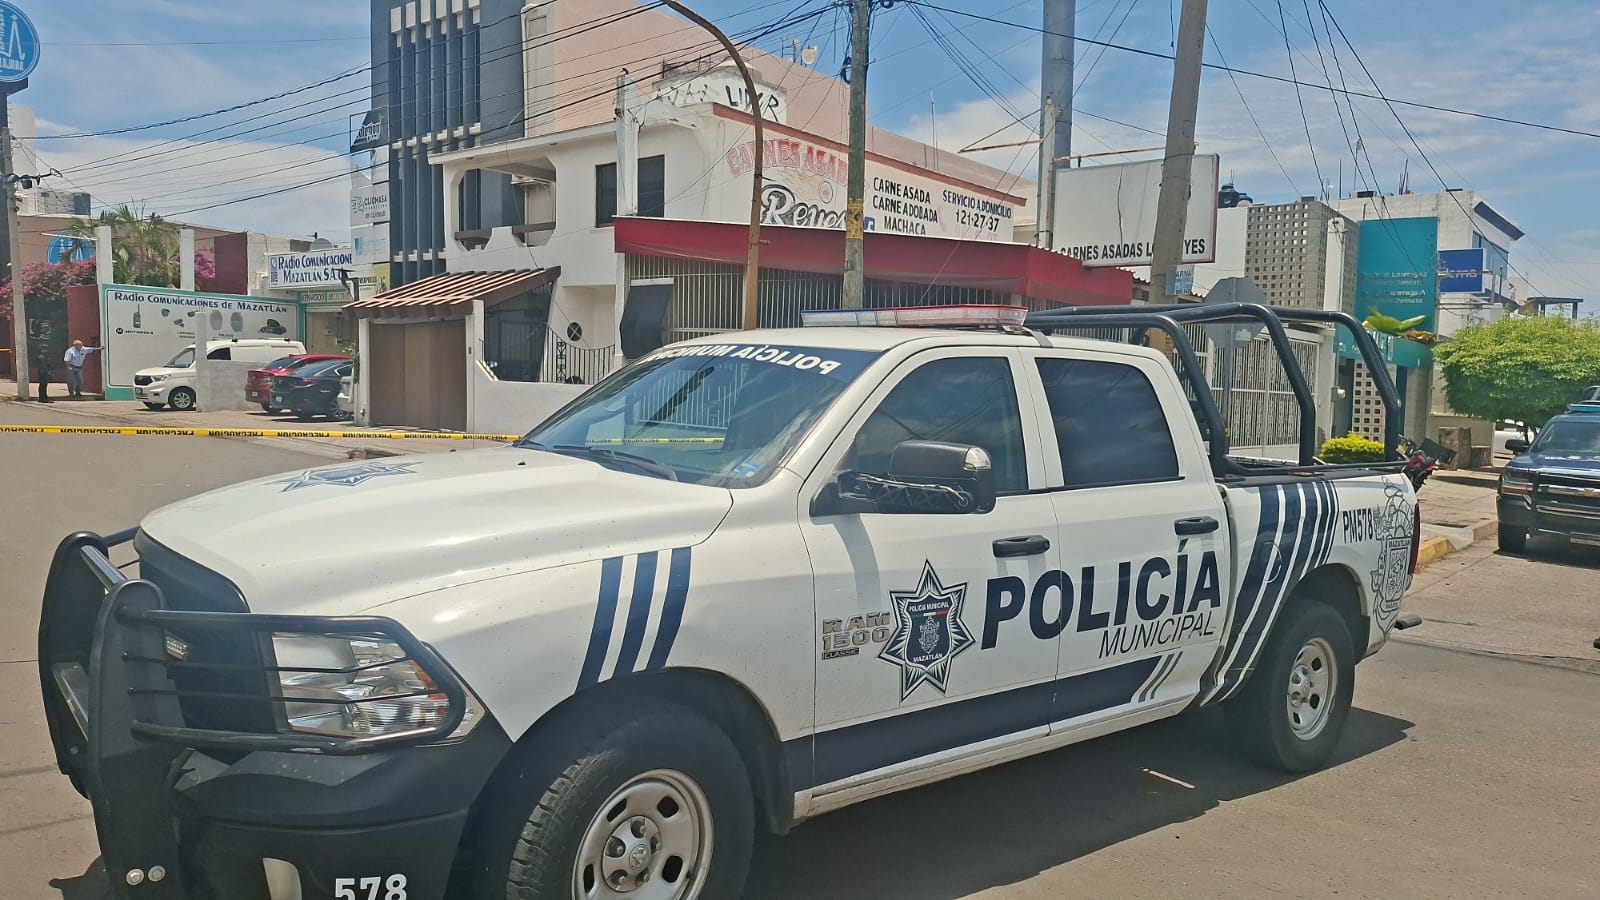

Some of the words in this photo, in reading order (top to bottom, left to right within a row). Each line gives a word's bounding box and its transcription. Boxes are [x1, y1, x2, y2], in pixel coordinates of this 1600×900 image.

[873, 177, 901, 197] CARNE
[902, 185, 931, 204] ASADA
[872, 195, 901, 214] CARNE
[902, 201, 938, 223] ADOBADA
[942, 190, 975, 209] SERVICIO
[981, 201, 1012, 219] DOMICILIO
[884, 215, 926, 235] MACHACA
[301, 253, 352, 268] Comunicacione
[1101, 242, 1143, 259] ASADAS
[1342, 508, 1374, 544] PM578
[980, 538, 1221, 650] POLICÍA
[823, 611, 890, 634] RAM
[1099, 610, 1214, 659] MUNICIPAL
[823, 627, 890, 650] 1500
[334, 873, 407, 900] 578
